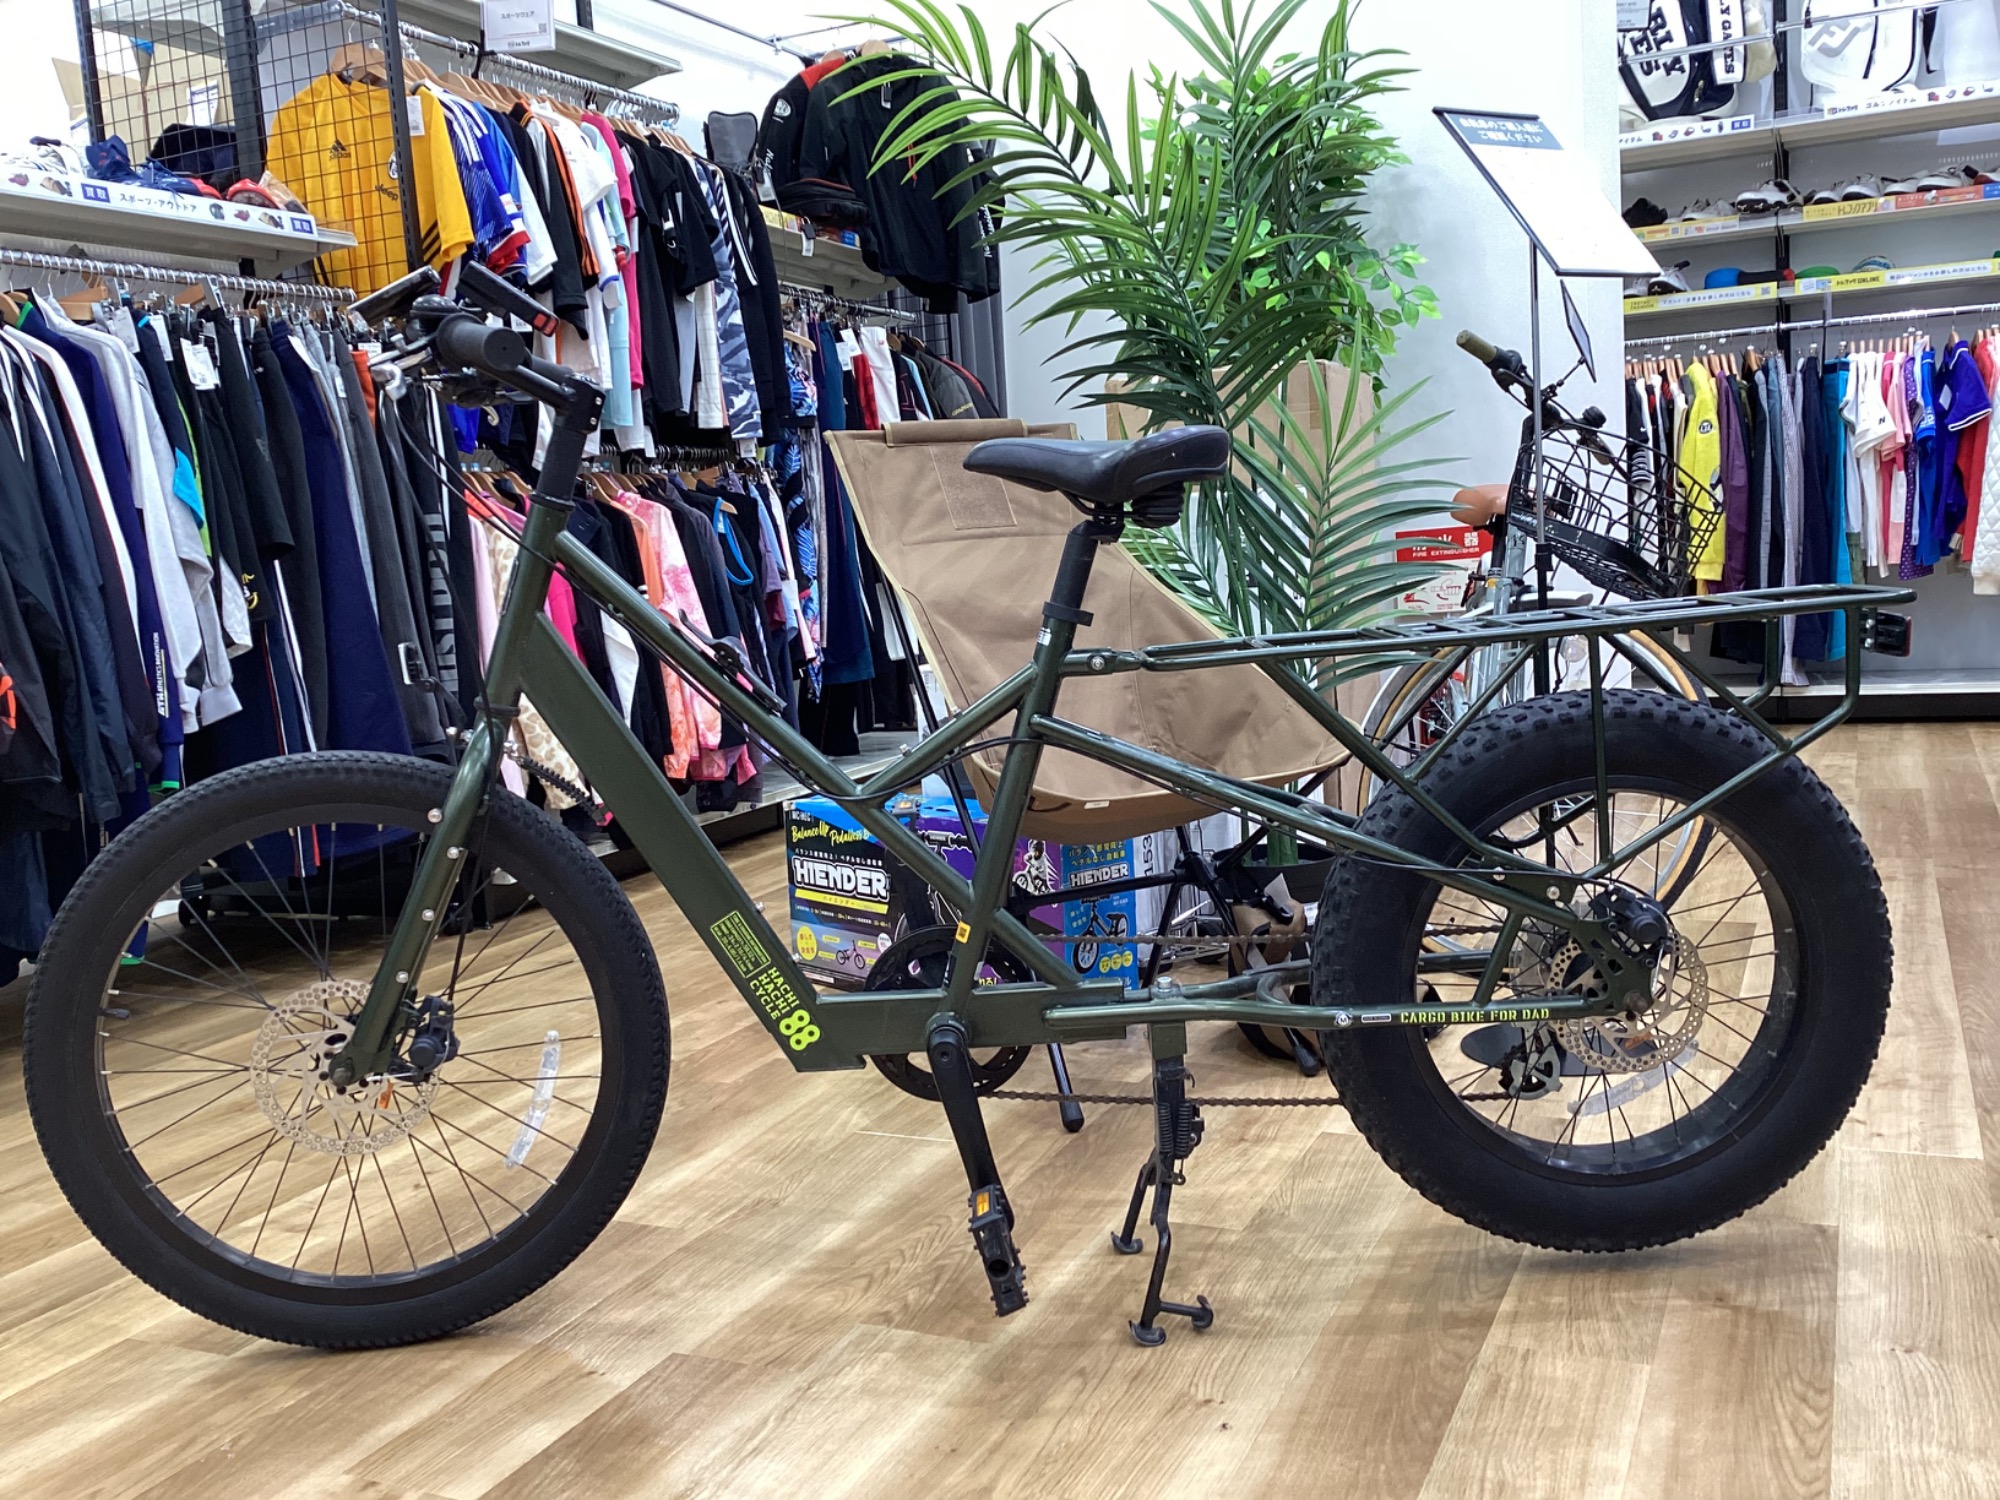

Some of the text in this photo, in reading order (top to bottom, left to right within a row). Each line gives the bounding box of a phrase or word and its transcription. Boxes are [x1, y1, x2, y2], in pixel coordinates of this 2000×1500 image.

[84, 186, 107, 200] 買取
[792, 857, 889, 900] HIENDER
[1069, 861, 1130, 888] HIENDER
[749, 979, 781, 1020] CYCLE
[758, 972, 791, 1015] HACHI
[767, 966, 800, 1008] HACHI
[1400, 1007, 1550, 1024] CARGO BIKE FOR DAD
